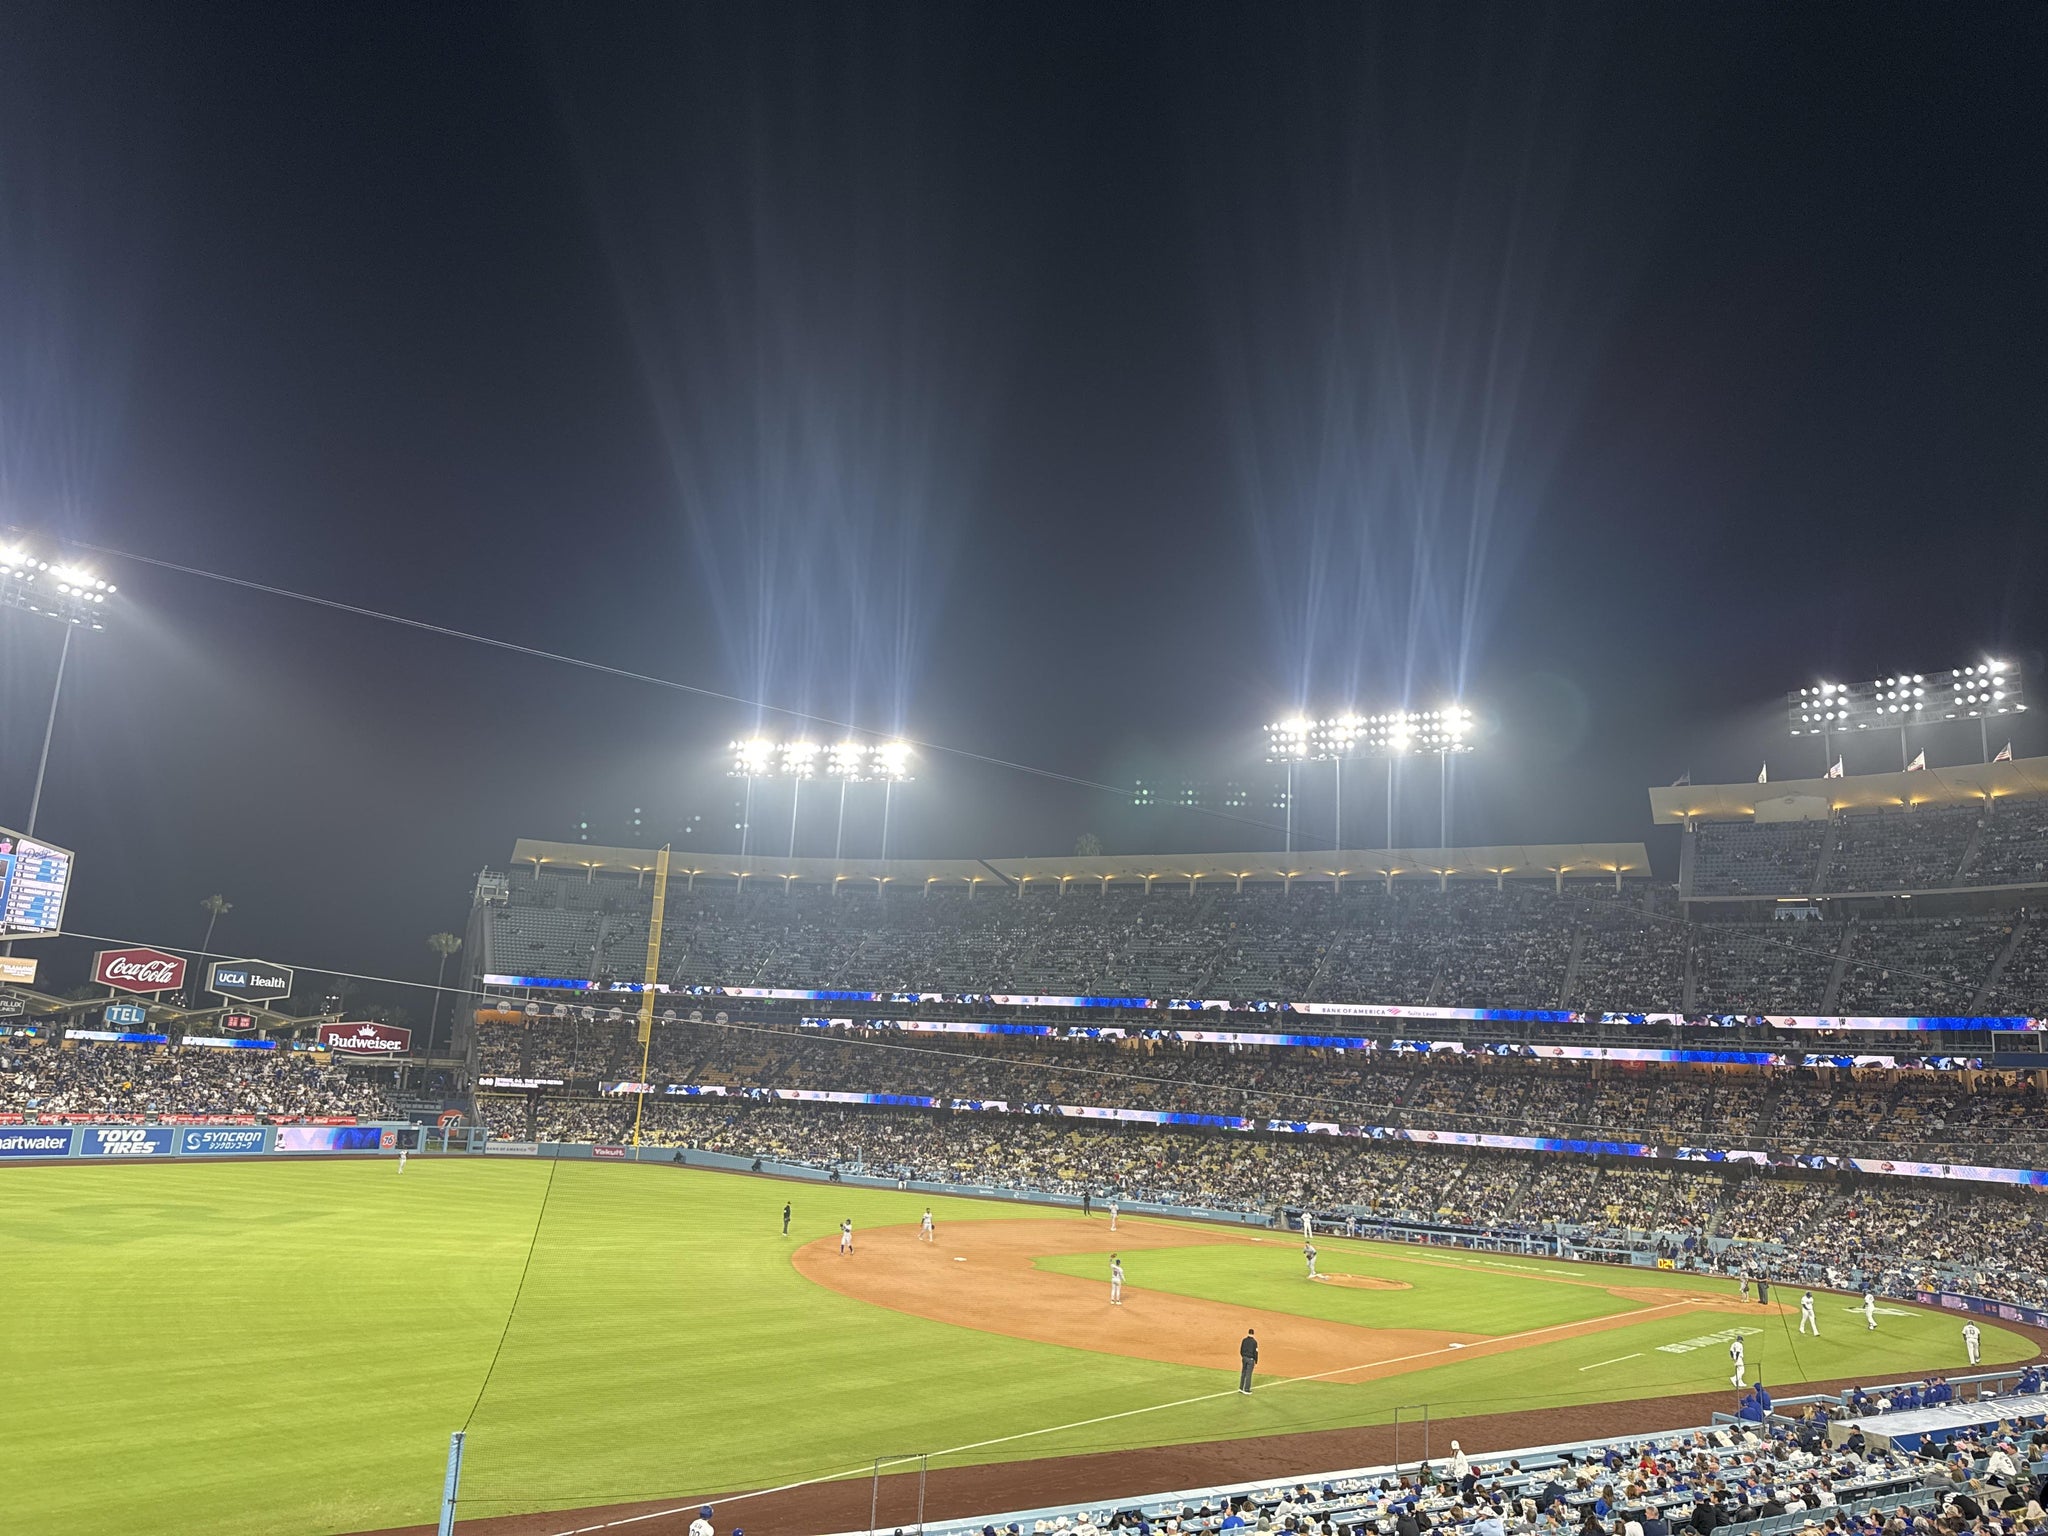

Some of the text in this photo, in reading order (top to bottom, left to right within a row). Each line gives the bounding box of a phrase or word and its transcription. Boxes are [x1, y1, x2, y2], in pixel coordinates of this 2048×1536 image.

[105, 957, 178, 983] Coca-Cola
[218, 973, 286, 988] UCLA Health
[0, 1000, 23, 1008] RLUX
[111, 1007, 140, 1022] TEL
[441, 1114, 462, 1128] 76
[97, 1130, 146, 1142] TOYO
[202, 1132, 262, 1142] SYNCRON
[383, 1134, 396, 1145] 76
[102, 1141, 156, 1154] TIRES
[594, 1148, 624, 1156] Yakult
